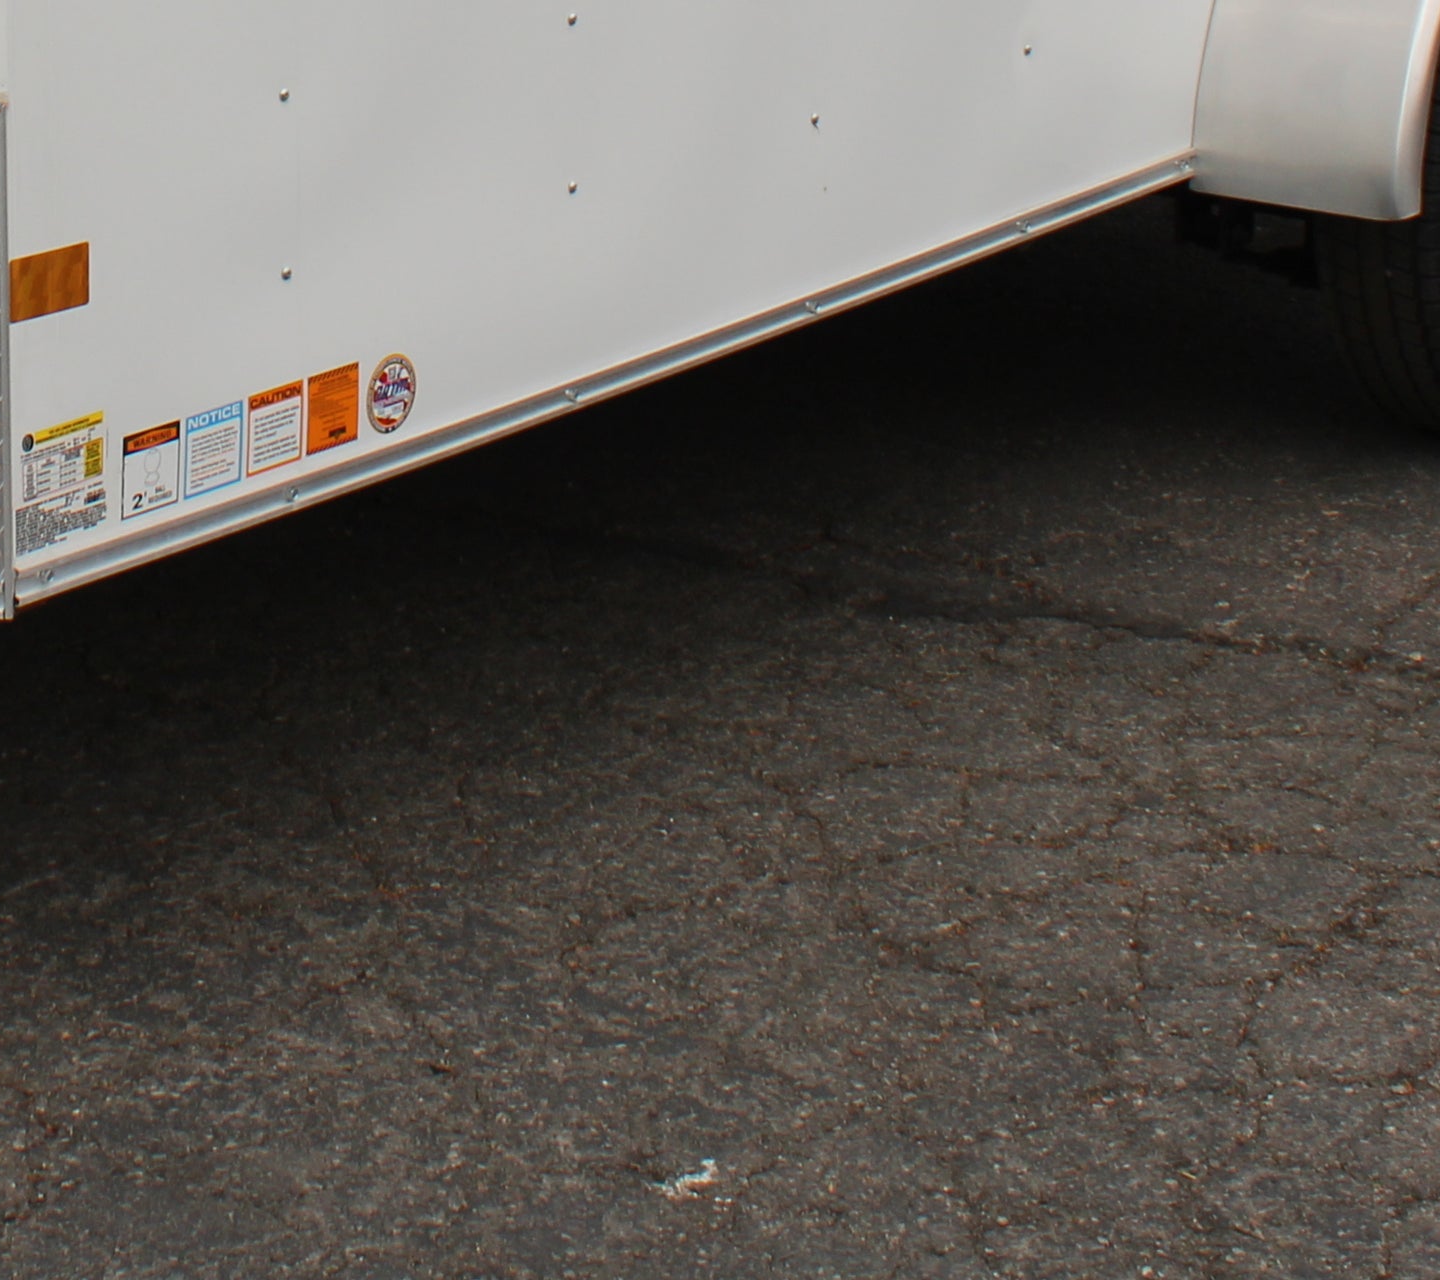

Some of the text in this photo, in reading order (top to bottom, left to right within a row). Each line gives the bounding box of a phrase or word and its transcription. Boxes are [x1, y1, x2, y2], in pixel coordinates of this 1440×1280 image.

[249, 384, 302, 409] CAUTION
[187, 402, 240, 431] NOTICE
[133, 430, 173, 448] WARNING
